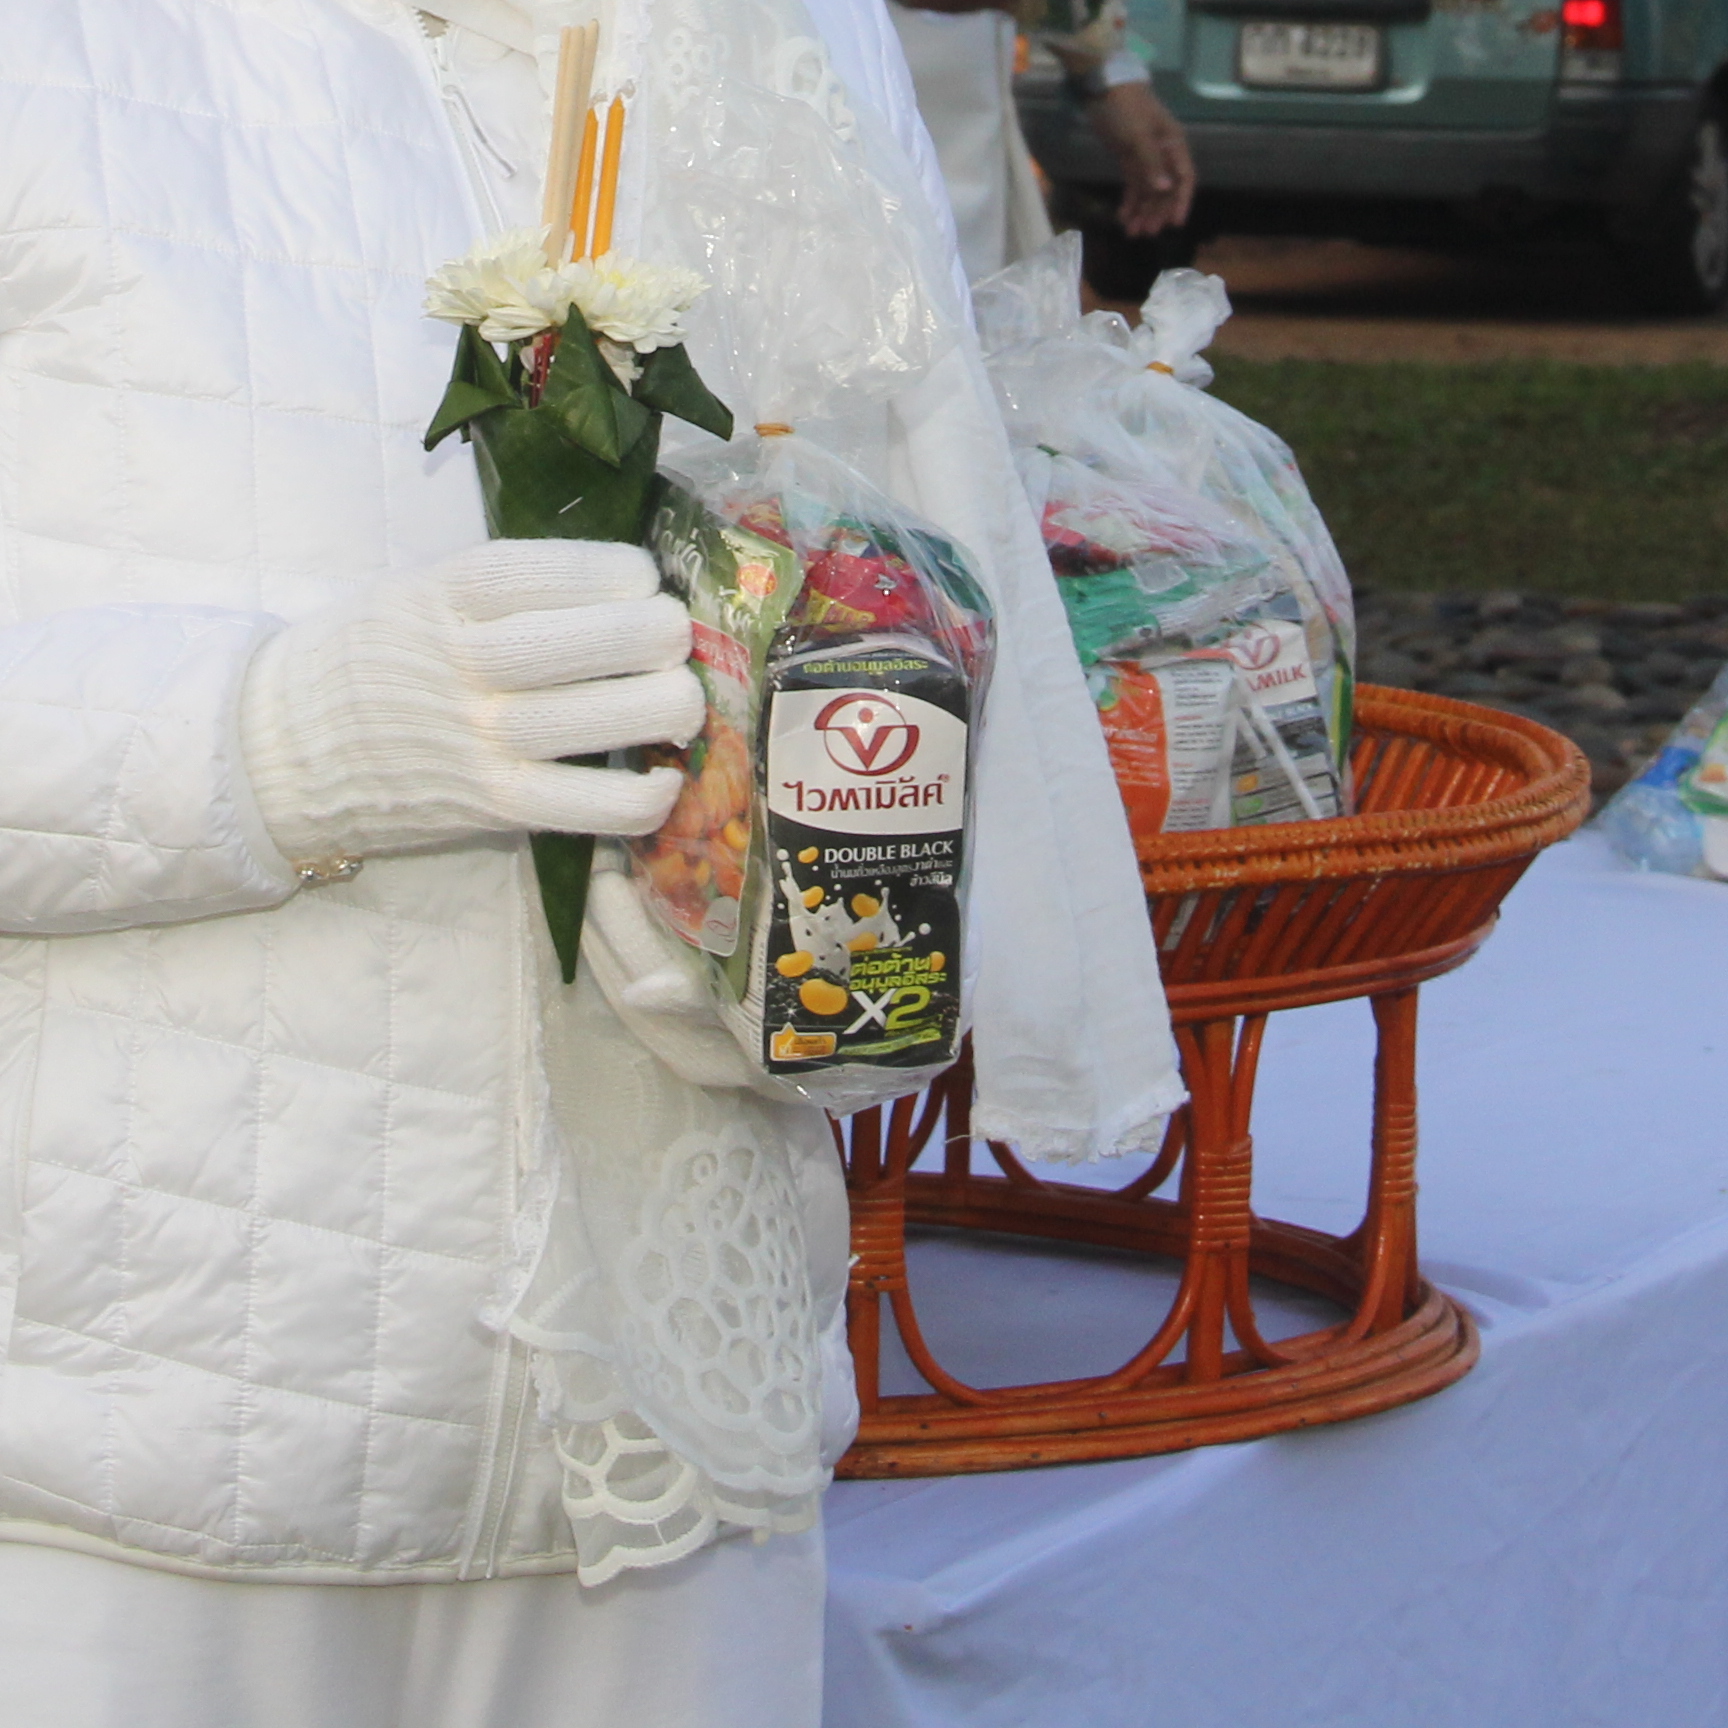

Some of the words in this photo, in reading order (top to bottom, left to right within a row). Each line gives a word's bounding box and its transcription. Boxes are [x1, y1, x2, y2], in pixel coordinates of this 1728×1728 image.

[824, 845, 897, 864] DOUBLE
[899, 840, 954, 859] BLACK
[850, 952, 931, 977] ต่อต้าน
[849, 972, 947, 994] อนุมูลอิสระ
[842, 985, 932, 1035] X2
